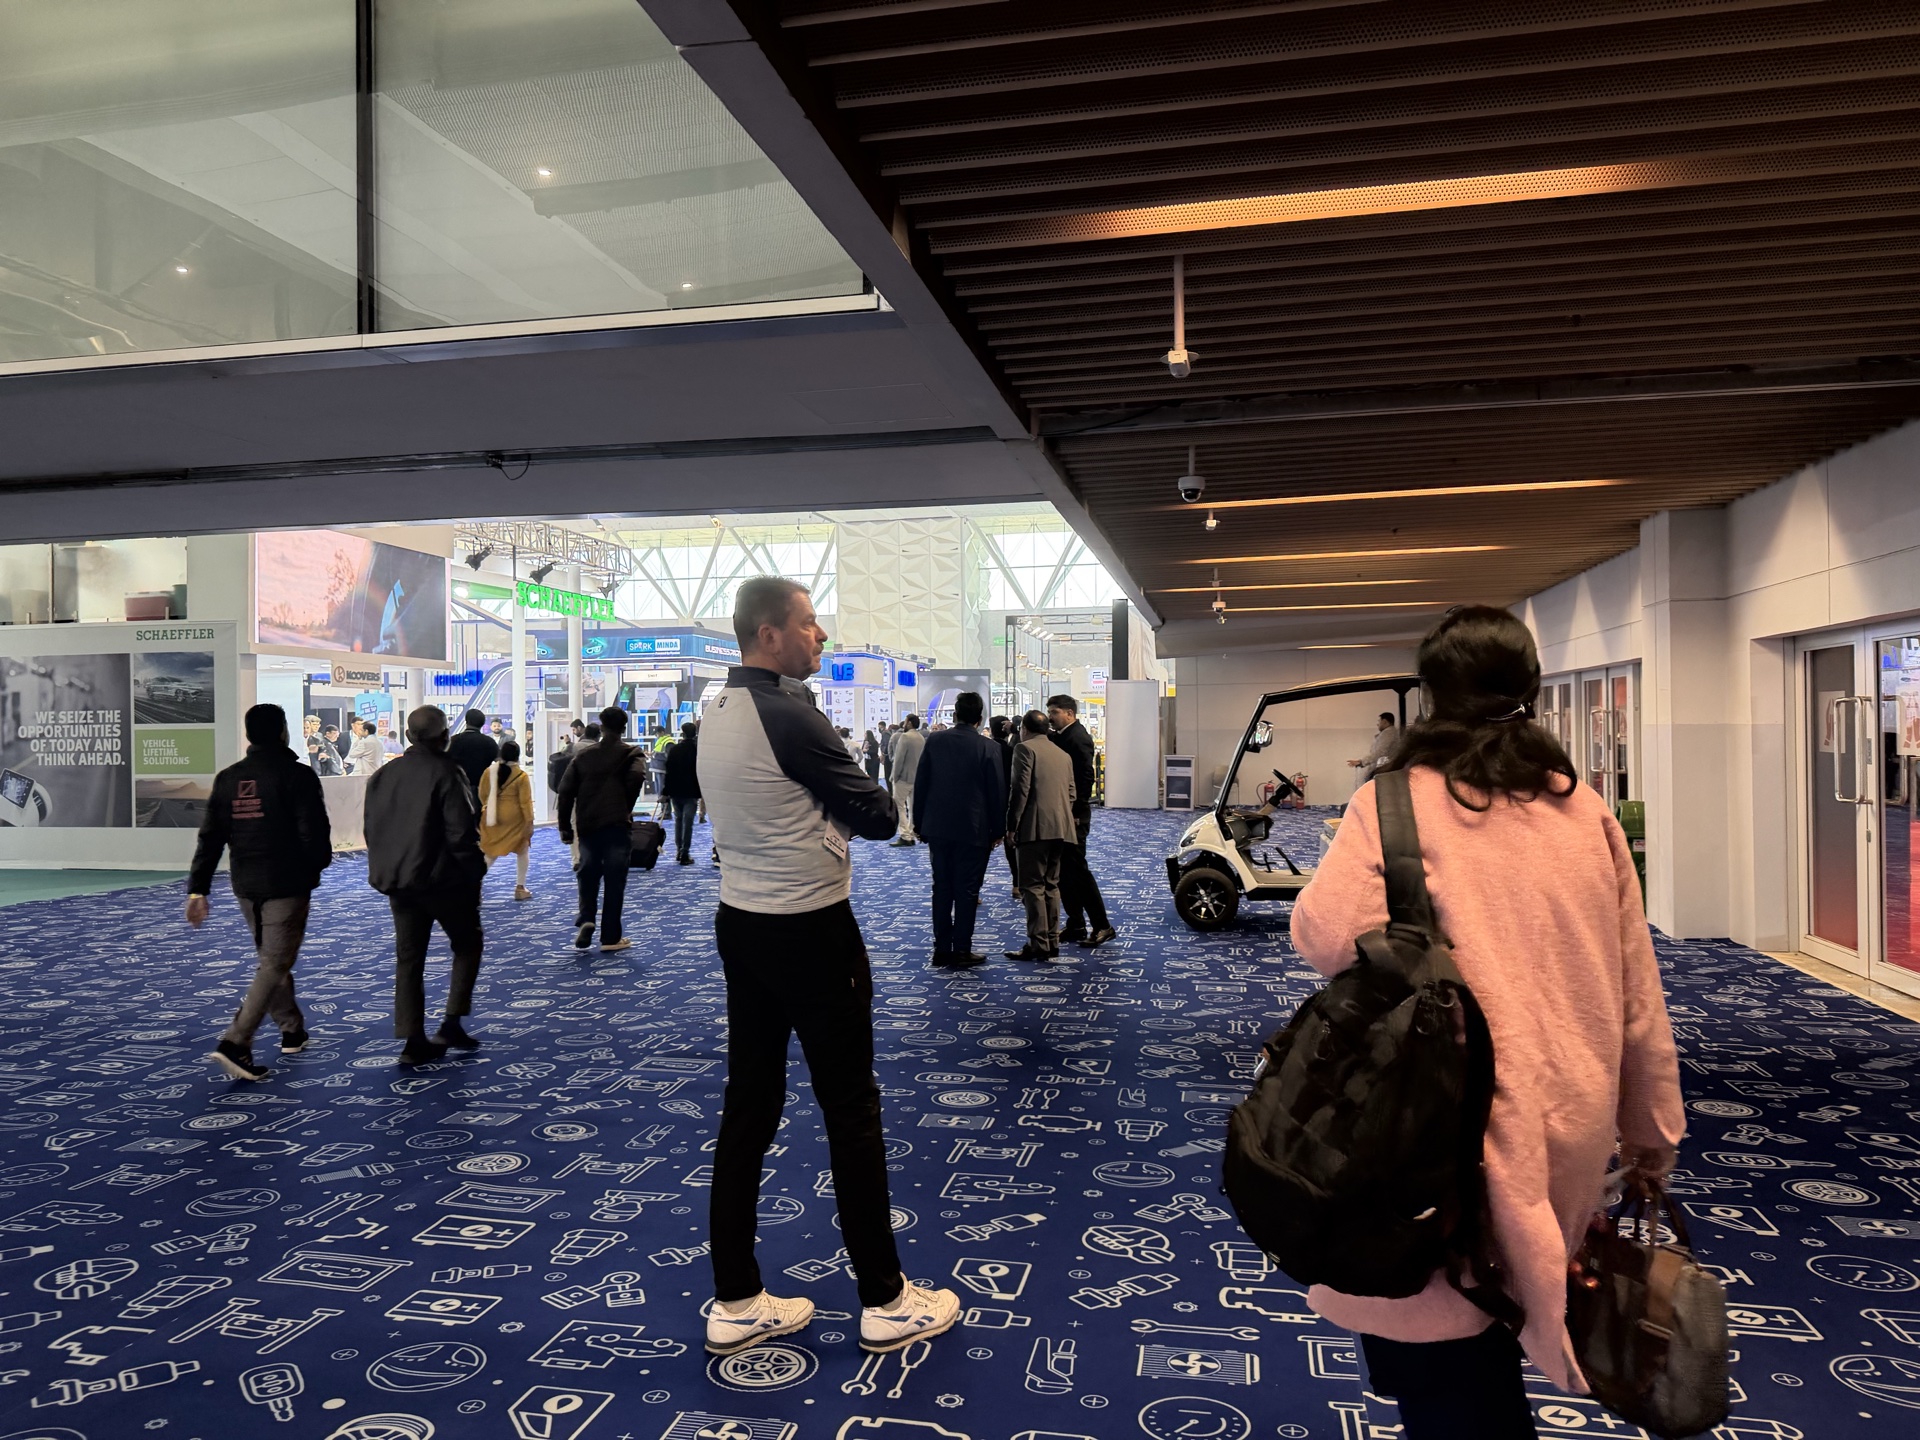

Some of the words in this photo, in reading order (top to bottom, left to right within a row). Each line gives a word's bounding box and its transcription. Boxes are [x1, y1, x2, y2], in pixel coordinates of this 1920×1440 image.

[516, 581, 617, 623] SCHAEFFLER
[136, 628, 215, 641] SCHAEFFLER
[656, 641, 679, 649] MINDA
[35, 711, 55, 724] WE
[58, 710, 94, 724] SEIZE
[96, 709, 121, 723] THE
[18, 724, 121, 738] OPPORTUNITIES
[30, 739, 47, 752] OF
[49, 739, 91, 752] TODAY
[94, 738, 121, 751] AND
[142, 739, 175, 748] VEHICLE
[36, 753, 75, 766] THINK
[78, 752, 126, 766] AHEAD.
[143, 748, 178, 757] LIFETIME
[143, 757, 190, 765] SOLUTIONS
